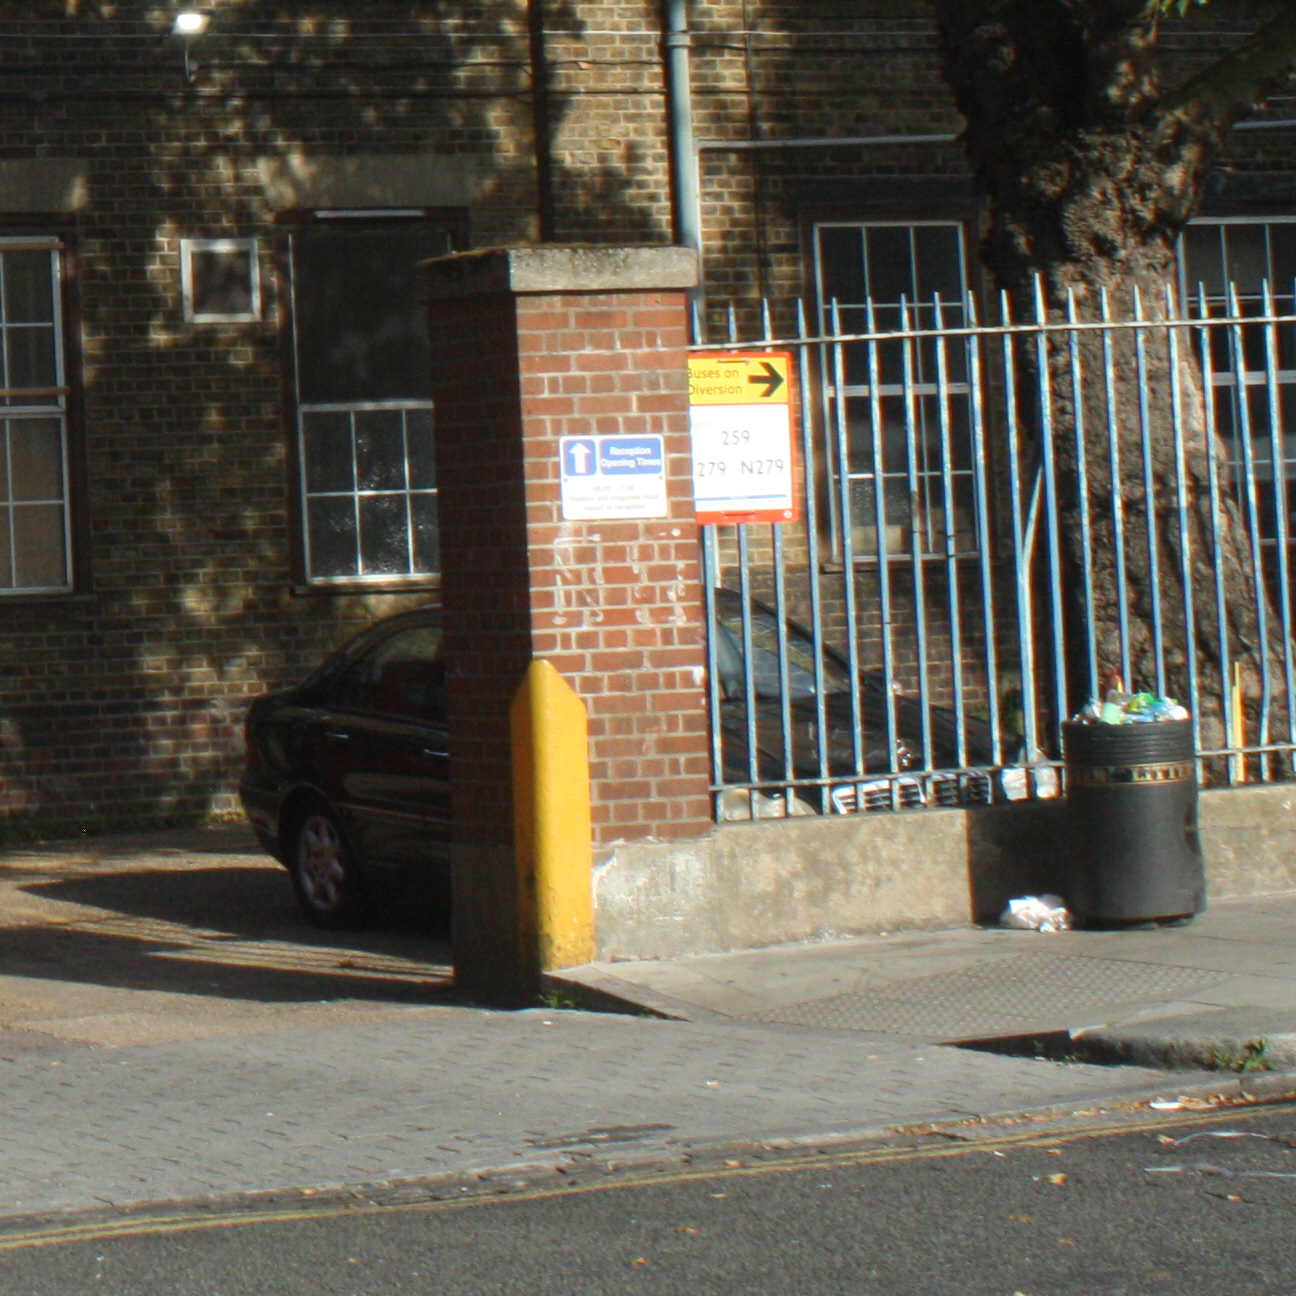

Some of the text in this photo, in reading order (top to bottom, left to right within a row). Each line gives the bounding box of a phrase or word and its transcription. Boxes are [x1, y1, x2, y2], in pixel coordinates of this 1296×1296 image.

[724, 370, 739, 378] on
[721, 430, 751, 446] 259
[609, 446, 652, 457] Reception
[600, 457, 662, 469] Opening Times
[697, 459, 784, 477] 279 N279
